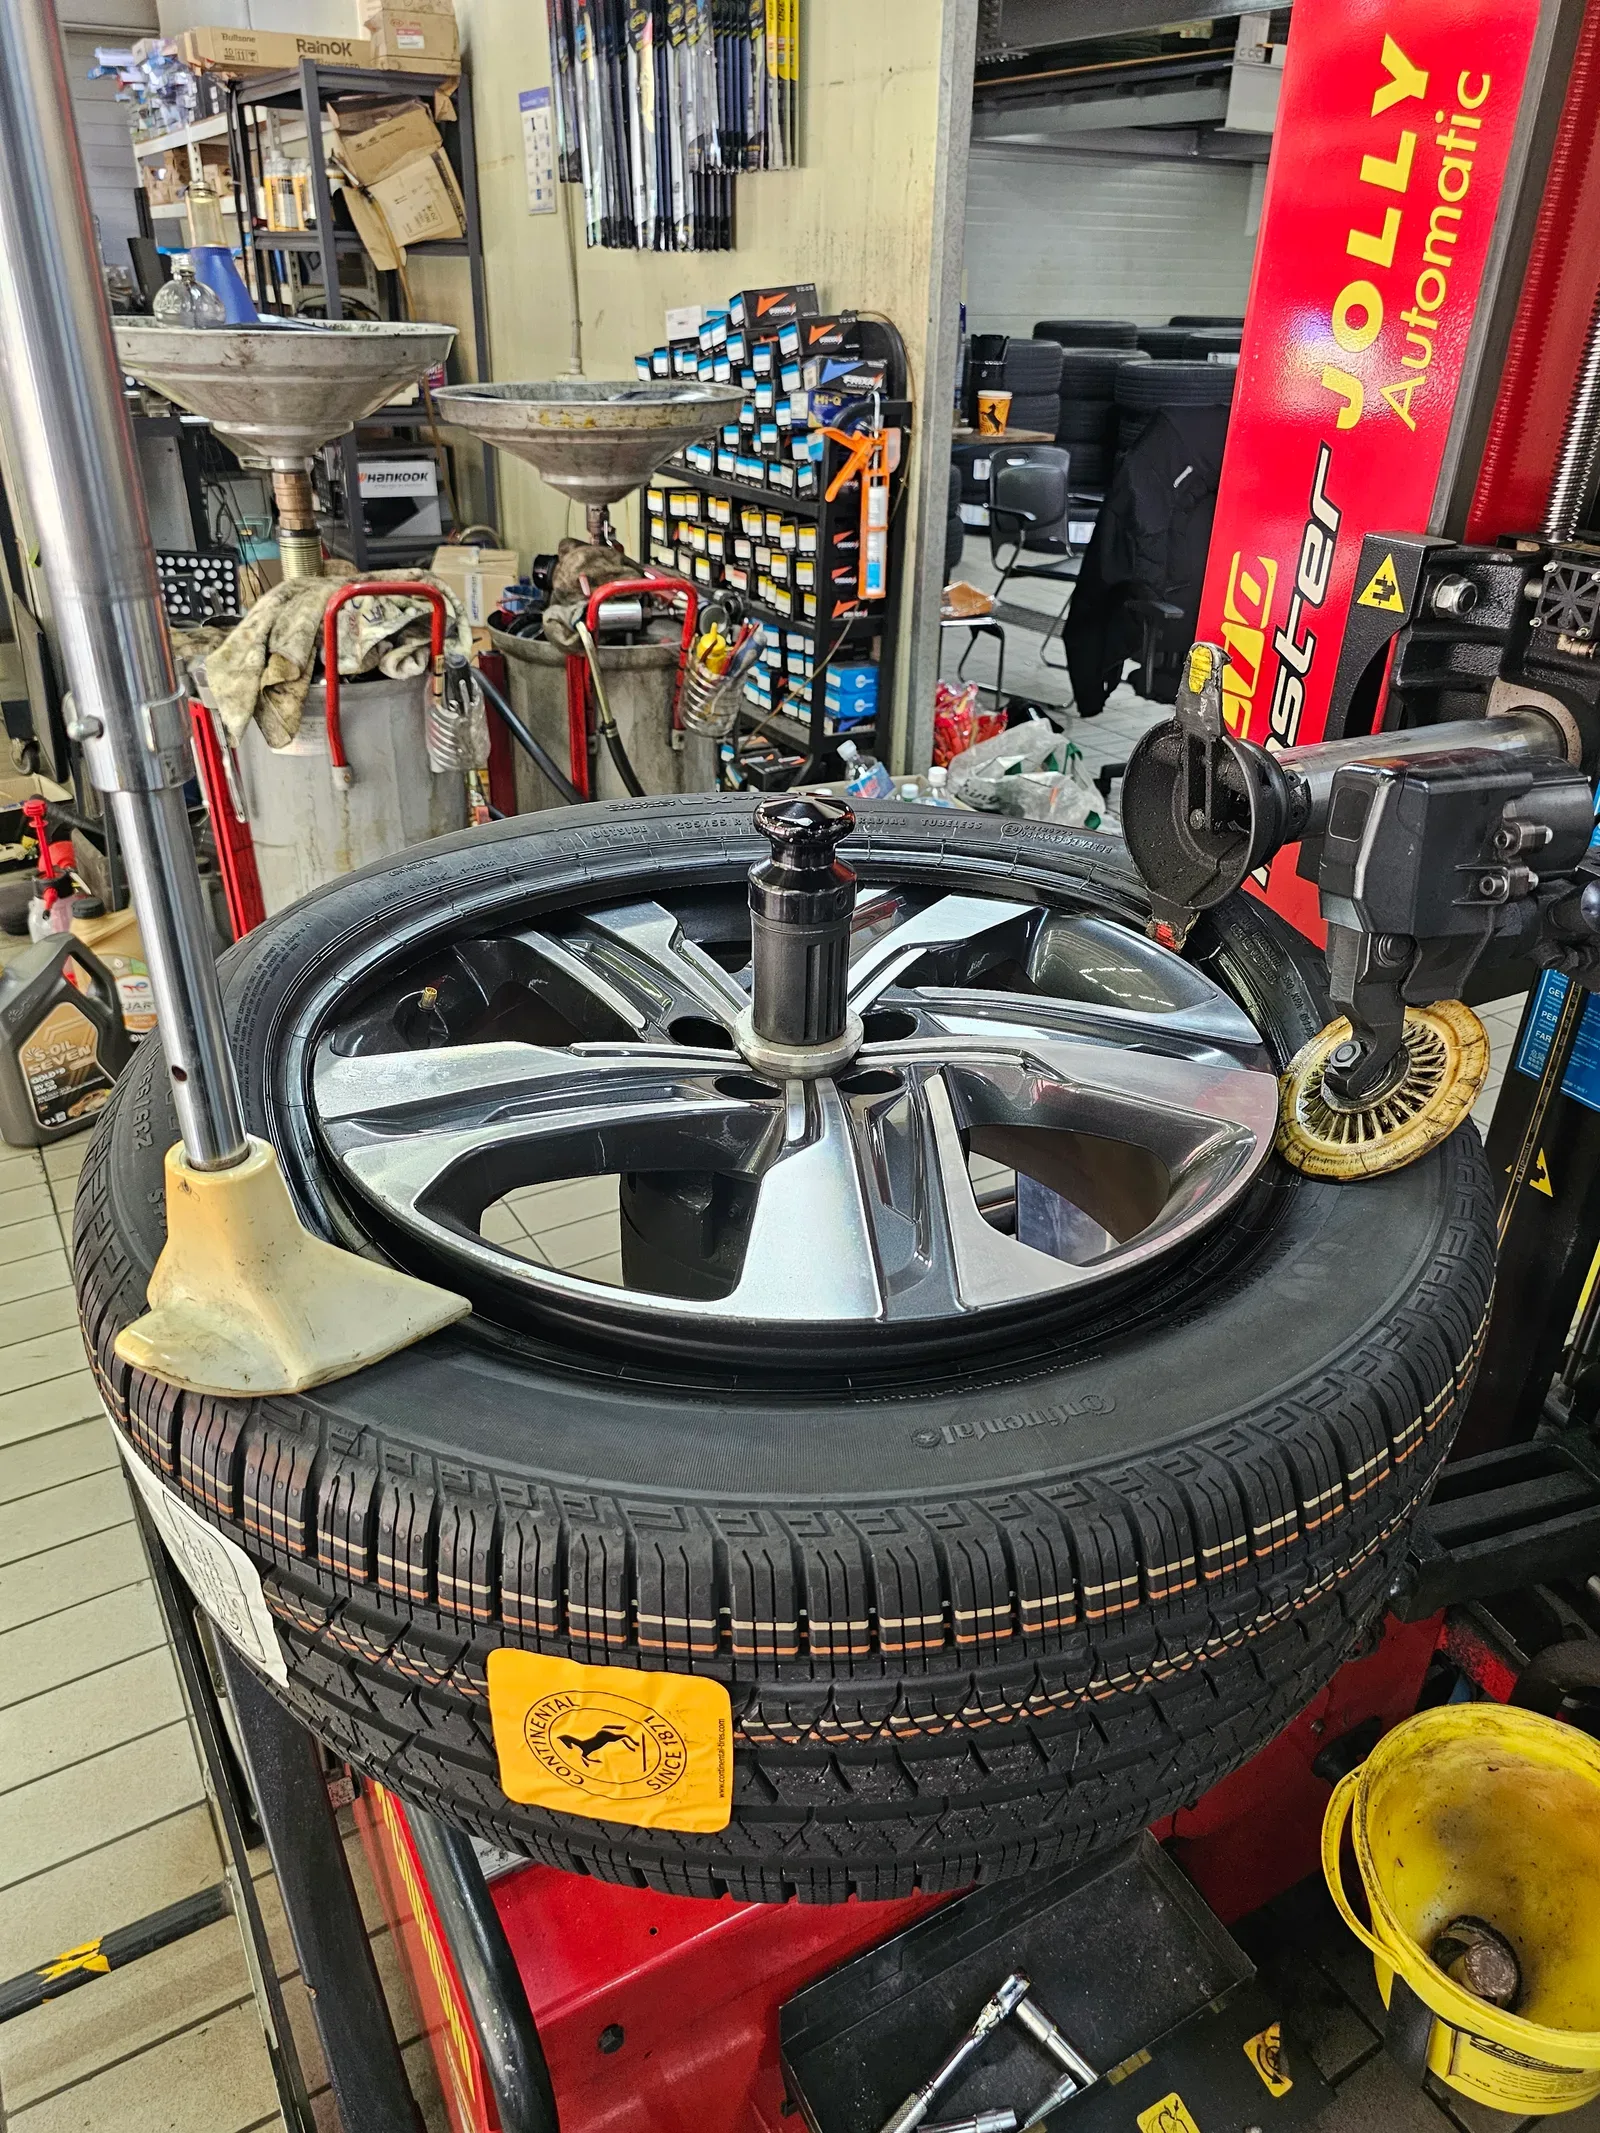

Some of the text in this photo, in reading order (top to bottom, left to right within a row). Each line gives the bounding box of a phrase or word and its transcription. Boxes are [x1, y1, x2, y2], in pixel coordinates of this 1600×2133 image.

[296, 38, 353, 57] RainOK
[1321, 33, 1429, 430] JOLLY
[1379, 70, 1490, 431] Automatic
[814, 393, 842, 406] Hi-Q
[857, 816, 983, 831] RADIAL TUBELESS
[1252, 930, 1283, 972] PRESSURE
[29, 1045, 92, 1075] SEVEN
[35, 1040, 77, 1062] S-OIL
[939, 1394, 1117, 1445] Continental
[524, 1695, 585, 1787] CONTINENTAL
[643, 1714, 682, 1791] SINCE 1871
[718, 1718, 726, 1800] www.continental-tires.com
